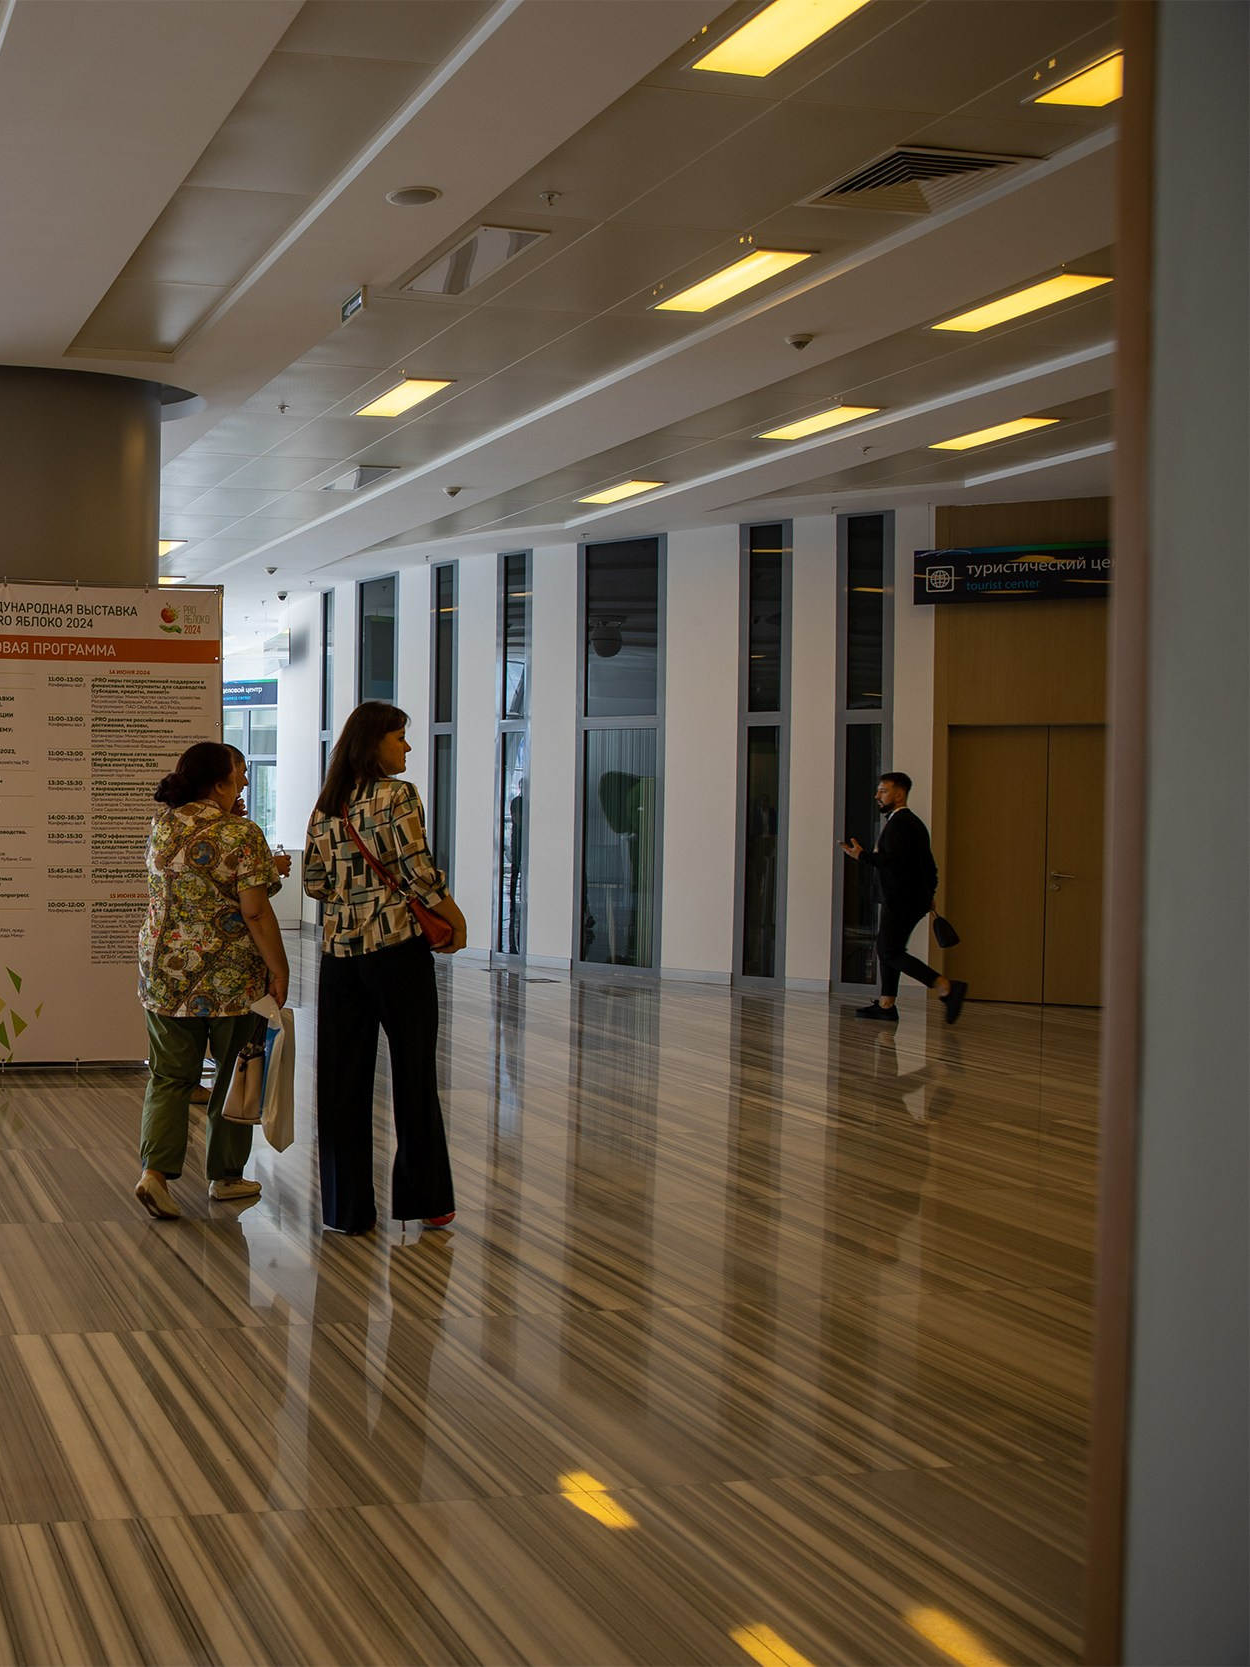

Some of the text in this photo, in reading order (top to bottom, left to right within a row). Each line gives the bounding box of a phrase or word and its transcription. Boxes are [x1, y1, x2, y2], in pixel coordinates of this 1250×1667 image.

[966, 556, 1086, 578] туристический
[966, 579, 1040, 590] tourist center
[76, 604, 138, 616] ВЫСТАВКА
[183, 606, 196, 614] PRO
[16, 616, 62, 628] ЯБЛОКО
[66, 618, 94, 628] 2024
[183, 614, 210, 624] ЯБЛОКО
[184, 624, 201, 634] 2024
[33, 642, 116, 656] ПРОГРАММА
